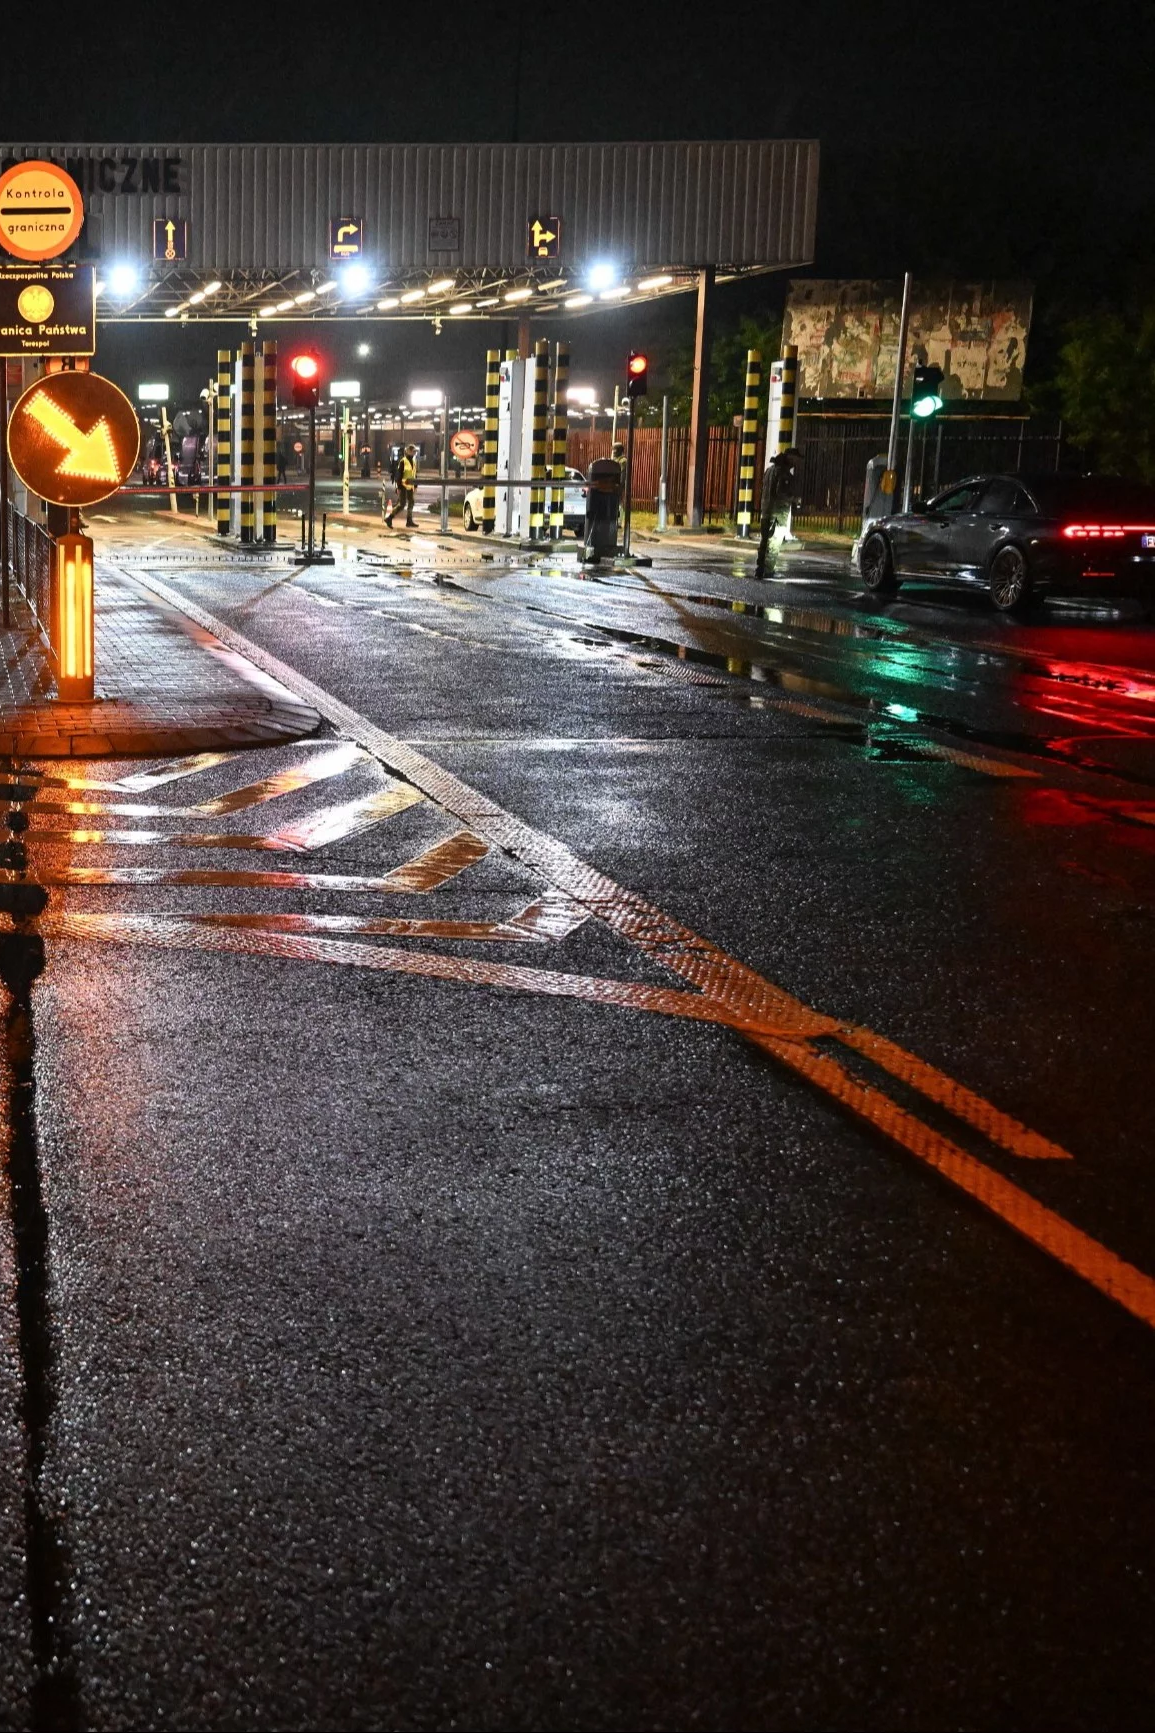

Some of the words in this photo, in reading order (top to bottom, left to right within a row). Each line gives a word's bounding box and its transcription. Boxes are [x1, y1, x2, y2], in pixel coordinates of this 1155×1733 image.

[2, 157, 181, 193] NICZNE
[6, 188, 64, 198] Kontrola
[8, 222, 65, 235] graniczna
[51, 271, 74, 279] Polska
[38, 324, 87, 335] Państwa
[21, 340, 50, 349] Terespol
